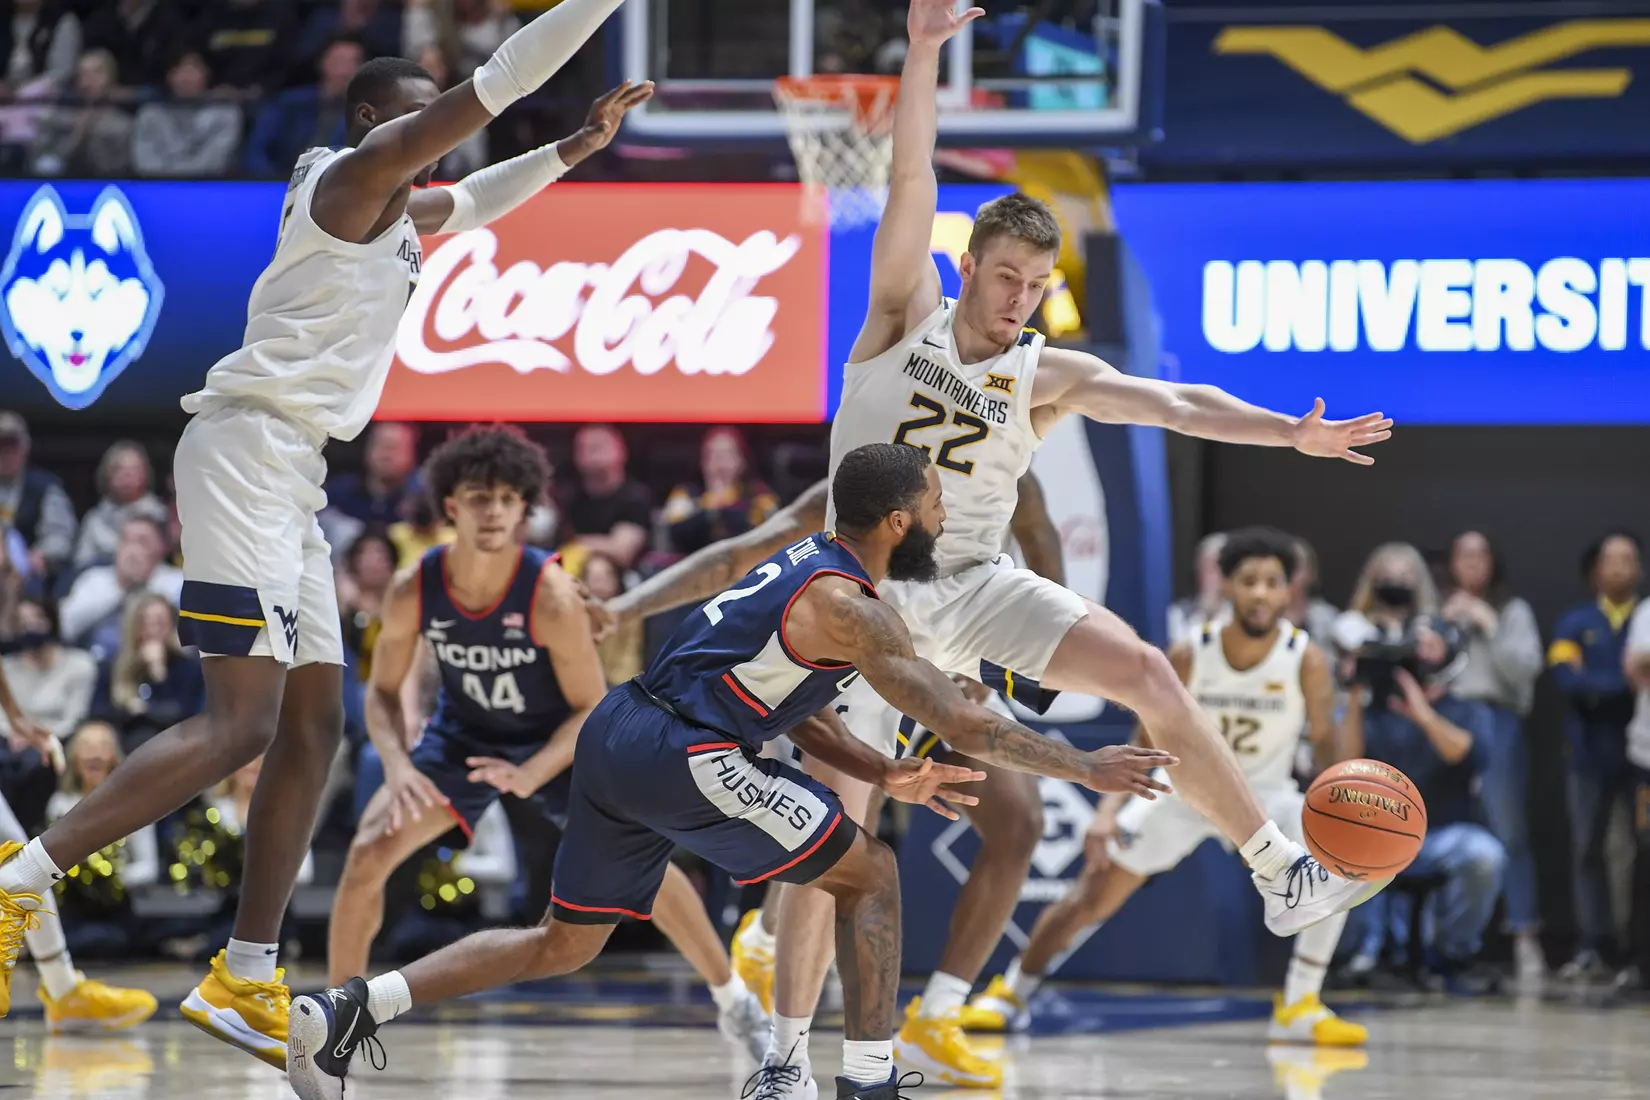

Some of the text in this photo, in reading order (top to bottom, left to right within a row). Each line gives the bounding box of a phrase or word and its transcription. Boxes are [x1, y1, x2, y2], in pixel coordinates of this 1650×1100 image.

[903, 353, 1008, 425] MOUNTAINEERS
[985, 373, 1015, 393] XII
[892, 391, 990, 477] 22
[702, 562, 782, 627] 2
[462, 671, 526, 714] 44
[1328, 784, 1411, 822] SPALDING
